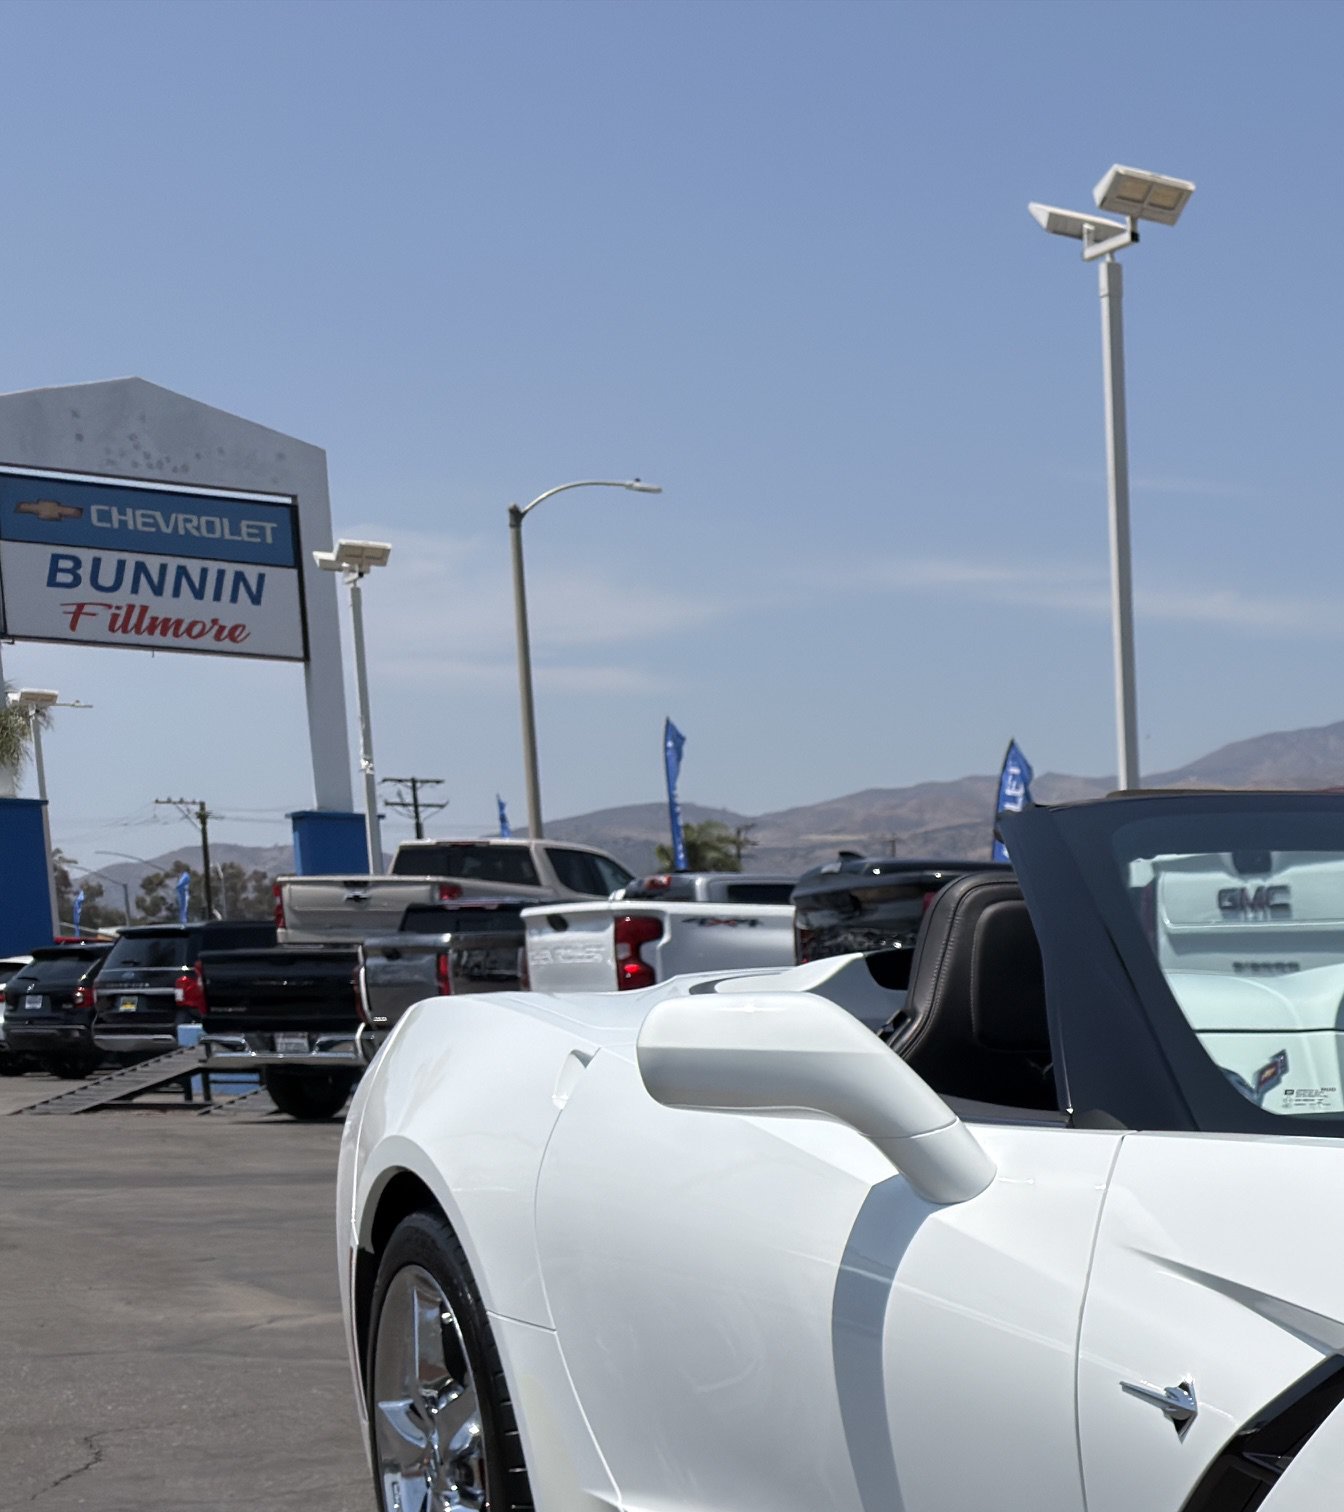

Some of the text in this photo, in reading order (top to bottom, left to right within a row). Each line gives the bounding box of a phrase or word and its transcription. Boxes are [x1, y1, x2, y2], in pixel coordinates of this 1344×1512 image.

[90, 505, 278, 544] CHEVROLET
[46, 552, 265, 606] BUNNIN
[60, 602, 251, 644] Fillmore
[1217, 885, 1291, 914] GMC
